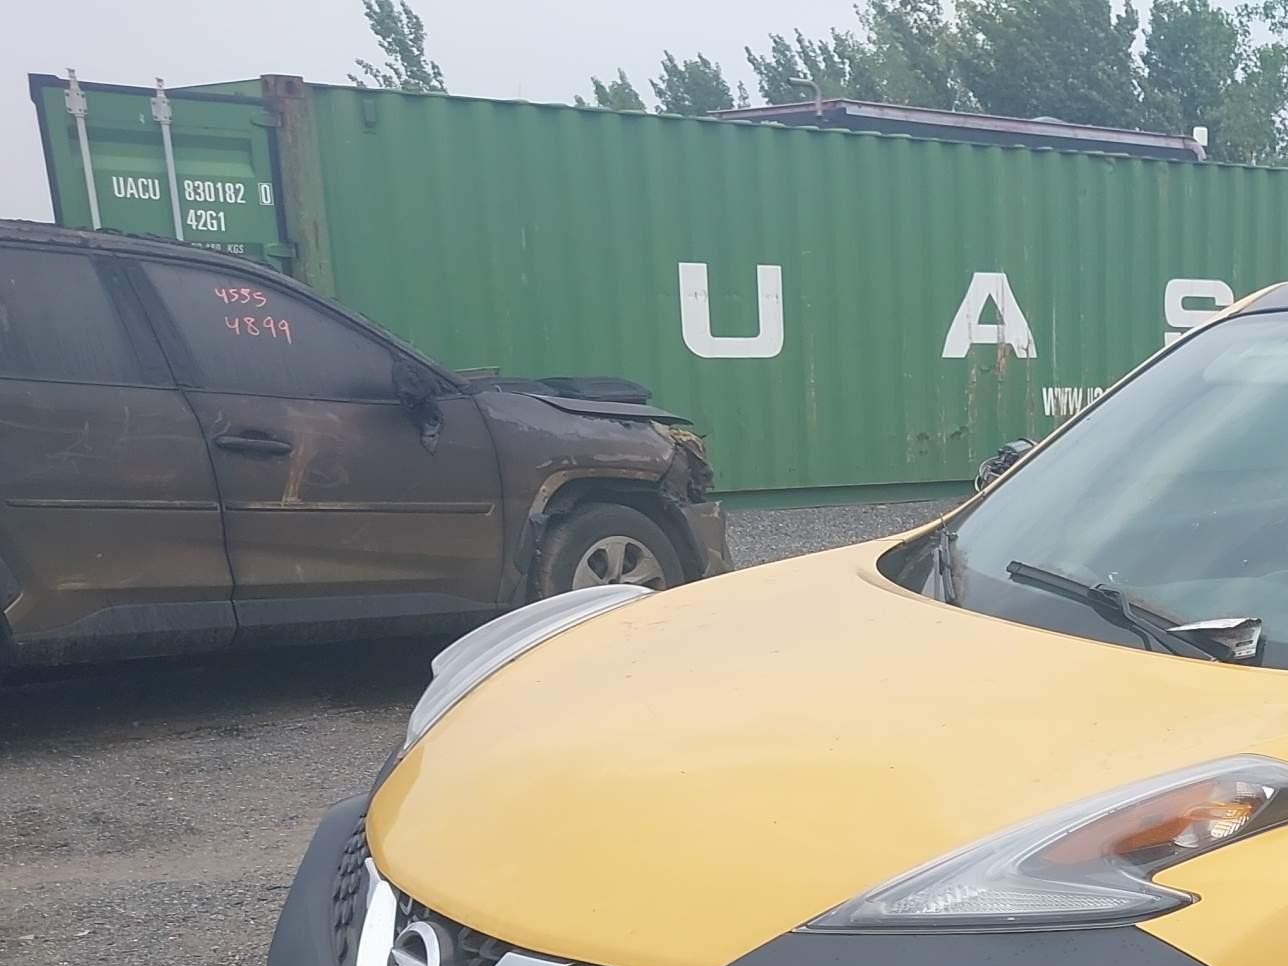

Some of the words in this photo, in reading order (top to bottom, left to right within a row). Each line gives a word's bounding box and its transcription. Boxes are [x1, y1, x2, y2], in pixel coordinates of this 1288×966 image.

[112, 176, 161, 200] UACU
[183, 180, 247, 204] 830182
[186, 209, 227, 232] 42G1
[224, 316, 293, 345] 4899
